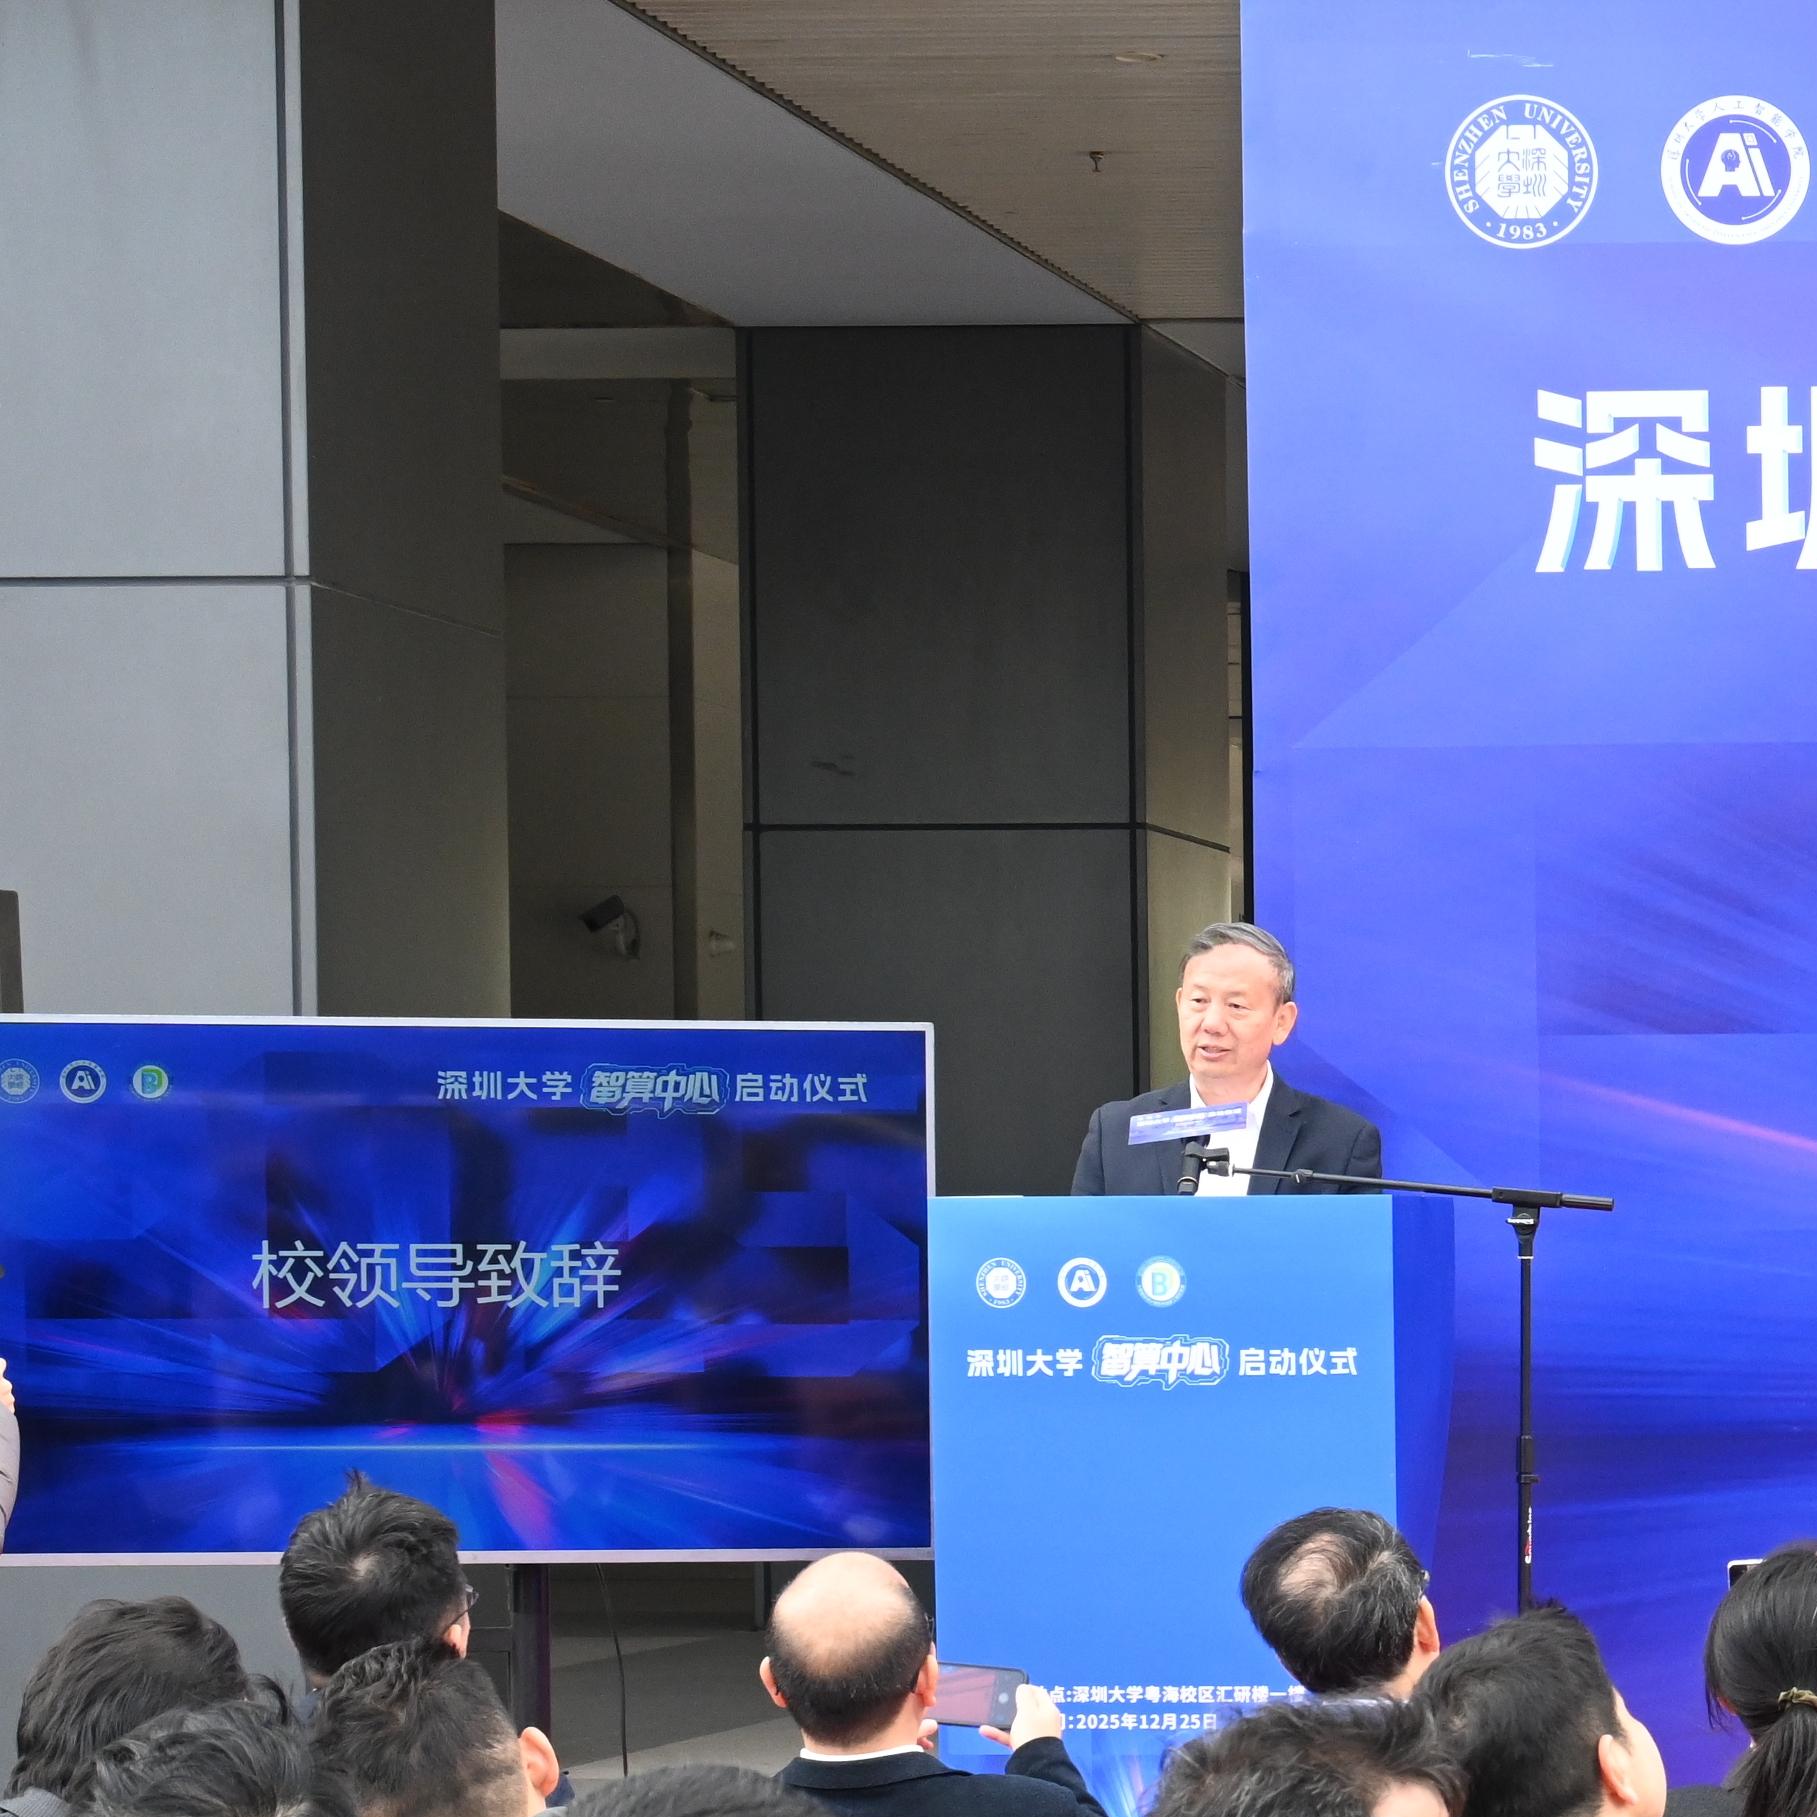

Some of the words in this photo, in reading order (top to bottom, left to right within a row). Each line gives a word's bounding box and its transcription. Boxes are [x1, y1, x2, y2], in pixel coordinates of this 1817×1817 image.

[1453, 105, 1508, 214] SHENZHEN
[1523, 102, 1591, 213] UNIVERSITY
[1496, 222, 1547, 240] 1983
[437, 1070, 573, 1101] 深圳大学
[589, 1068, 719, 1112] 智算中心
[734, 1072, 868, 1103] 启动仪式
[251, 1239, 623, 1310] 校领导致辞
[966, 1348, 1084, 1378] 深圳大学
[1100, 1340, 1222, 1385] 智算中心
[1238, 1347, 1358, 1377] 启动仪式
[1040, 1685, 1306, 1704] 点:深圳大学粤海校区汇研楼一
[1060, 1712, 1218, 1731] :2025年12月25日
